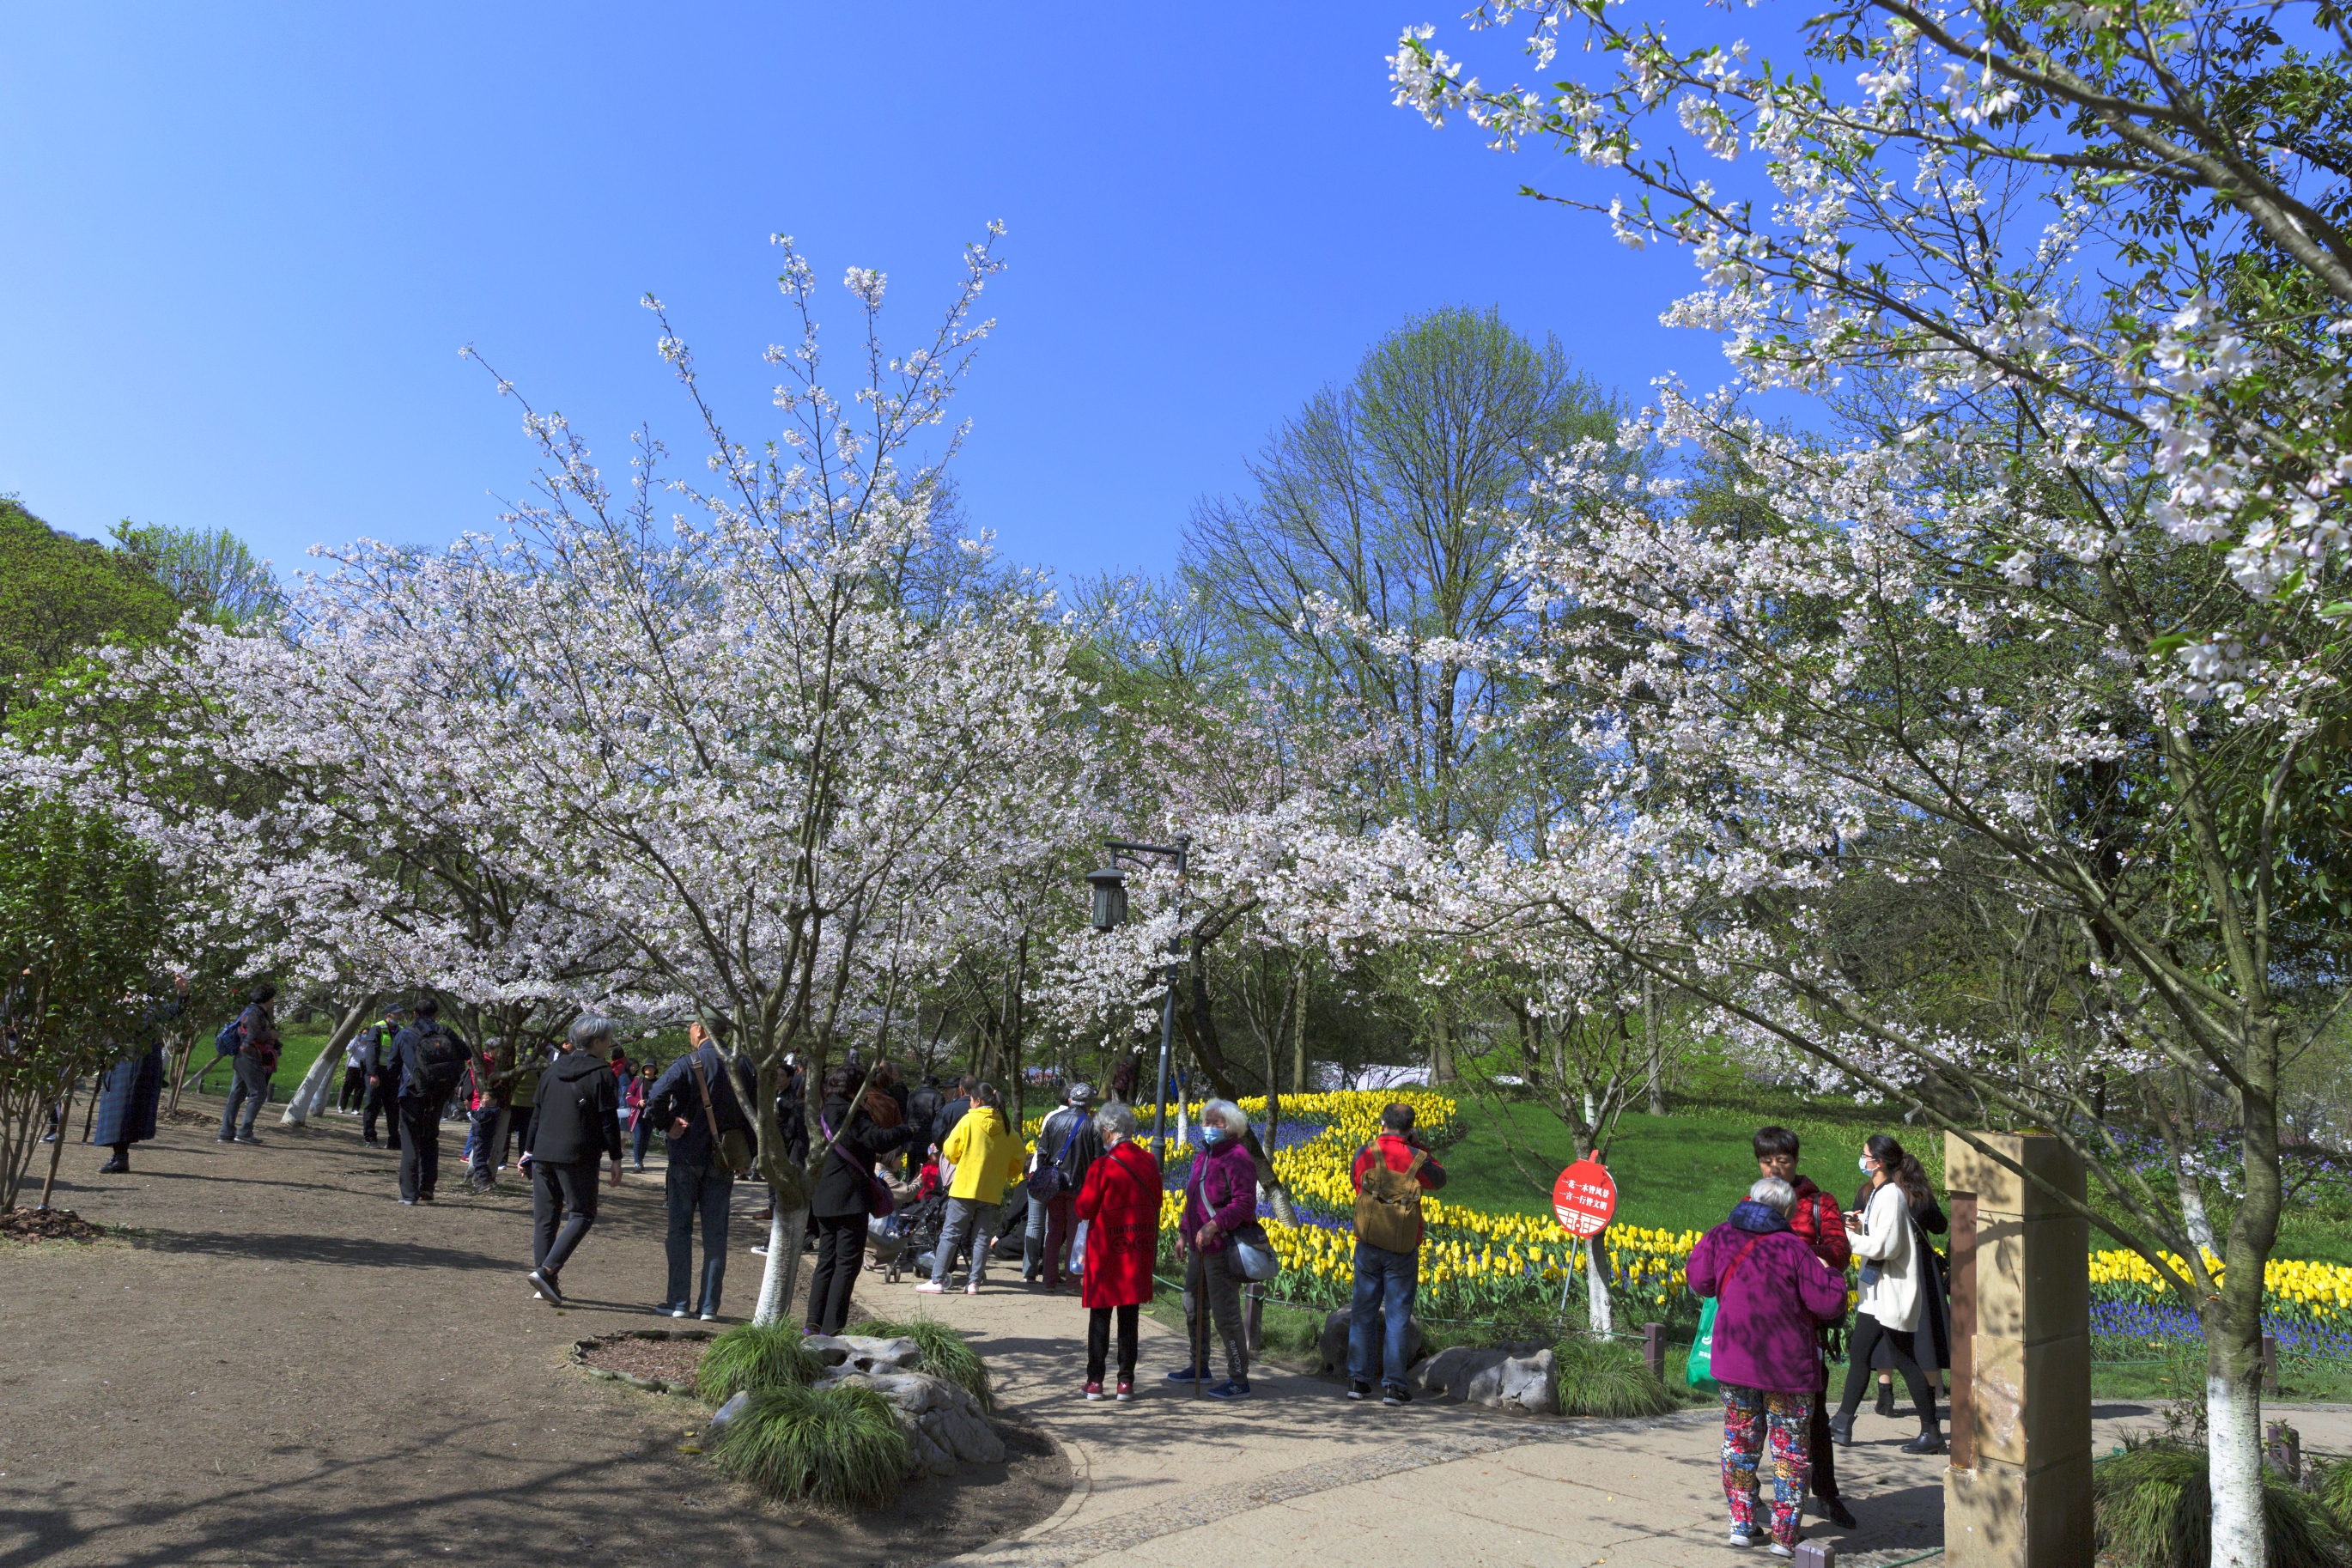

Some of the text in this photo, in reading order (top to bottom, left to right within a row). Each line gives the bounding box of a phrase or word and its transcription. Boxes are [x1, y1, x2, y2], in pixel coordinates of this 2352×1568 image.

[1561, 1179, 1610, 1199] 一花一木皆风景
[1559, 1191, 1608, 1211] 一言一行皆文明
